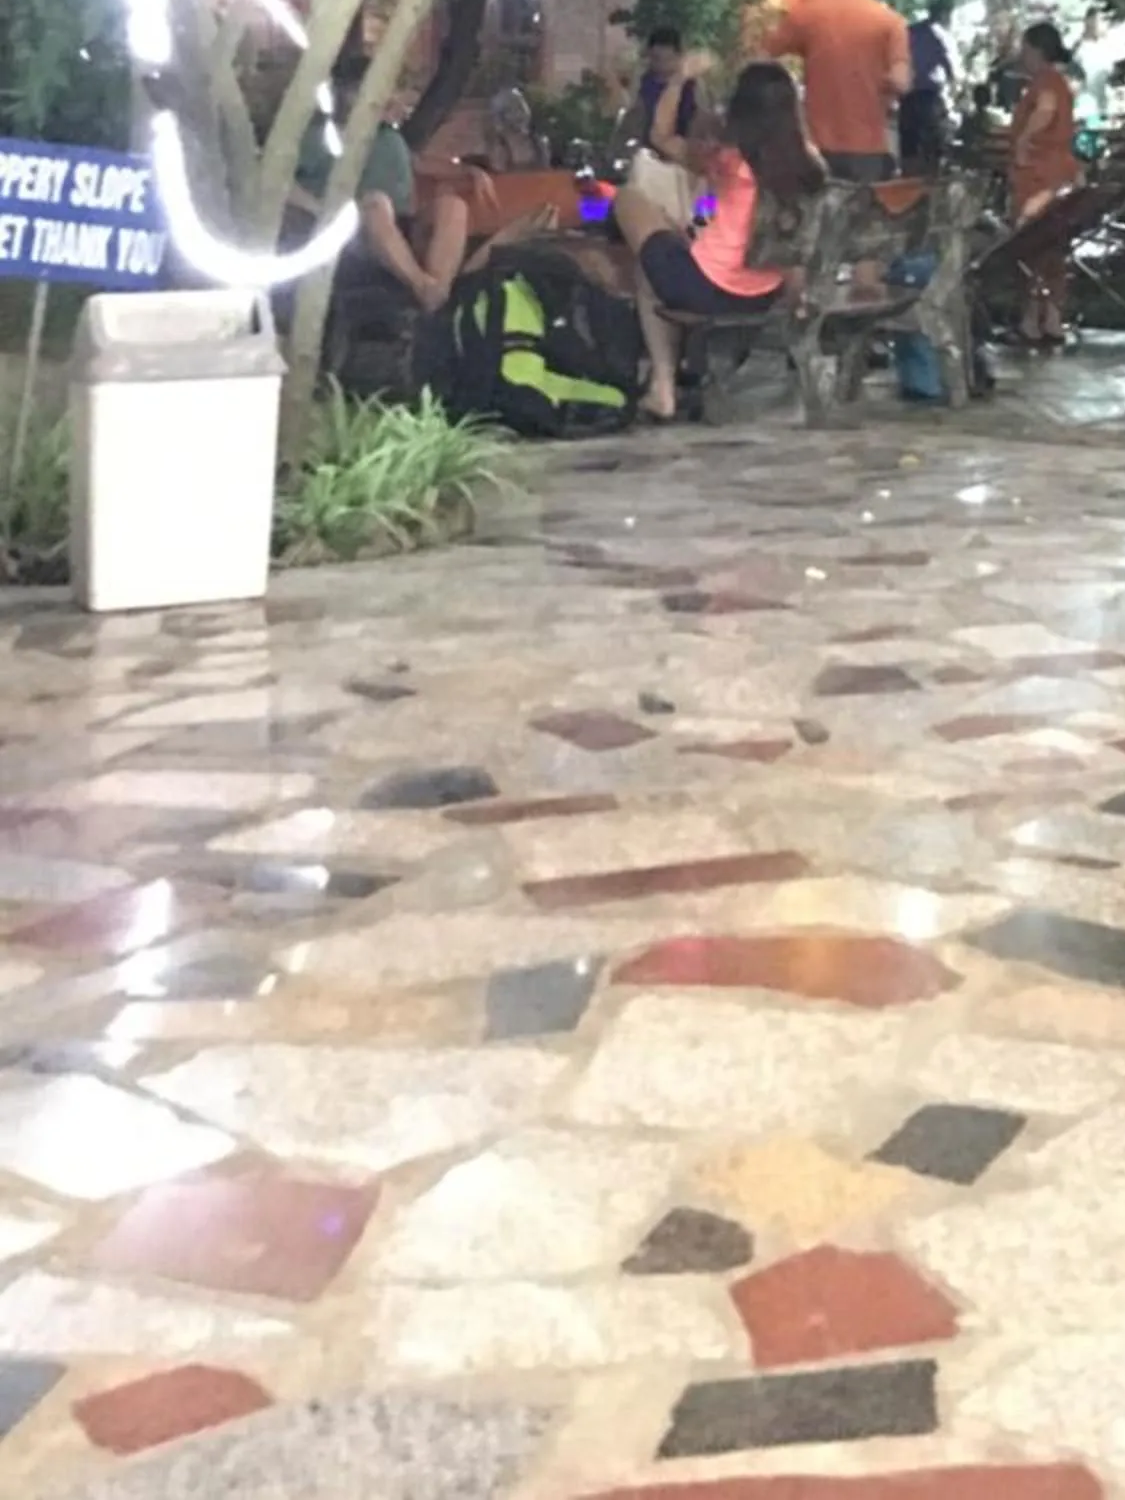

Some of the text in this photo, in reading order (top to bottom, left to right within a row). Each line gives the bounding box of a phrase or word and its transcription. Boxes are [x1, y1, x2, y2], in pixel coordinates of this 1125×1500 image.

[70, 161, 151, 212] SLOPE
[31, 218, 113, 269] THANK
[117, 228, 166, 275] YOU
